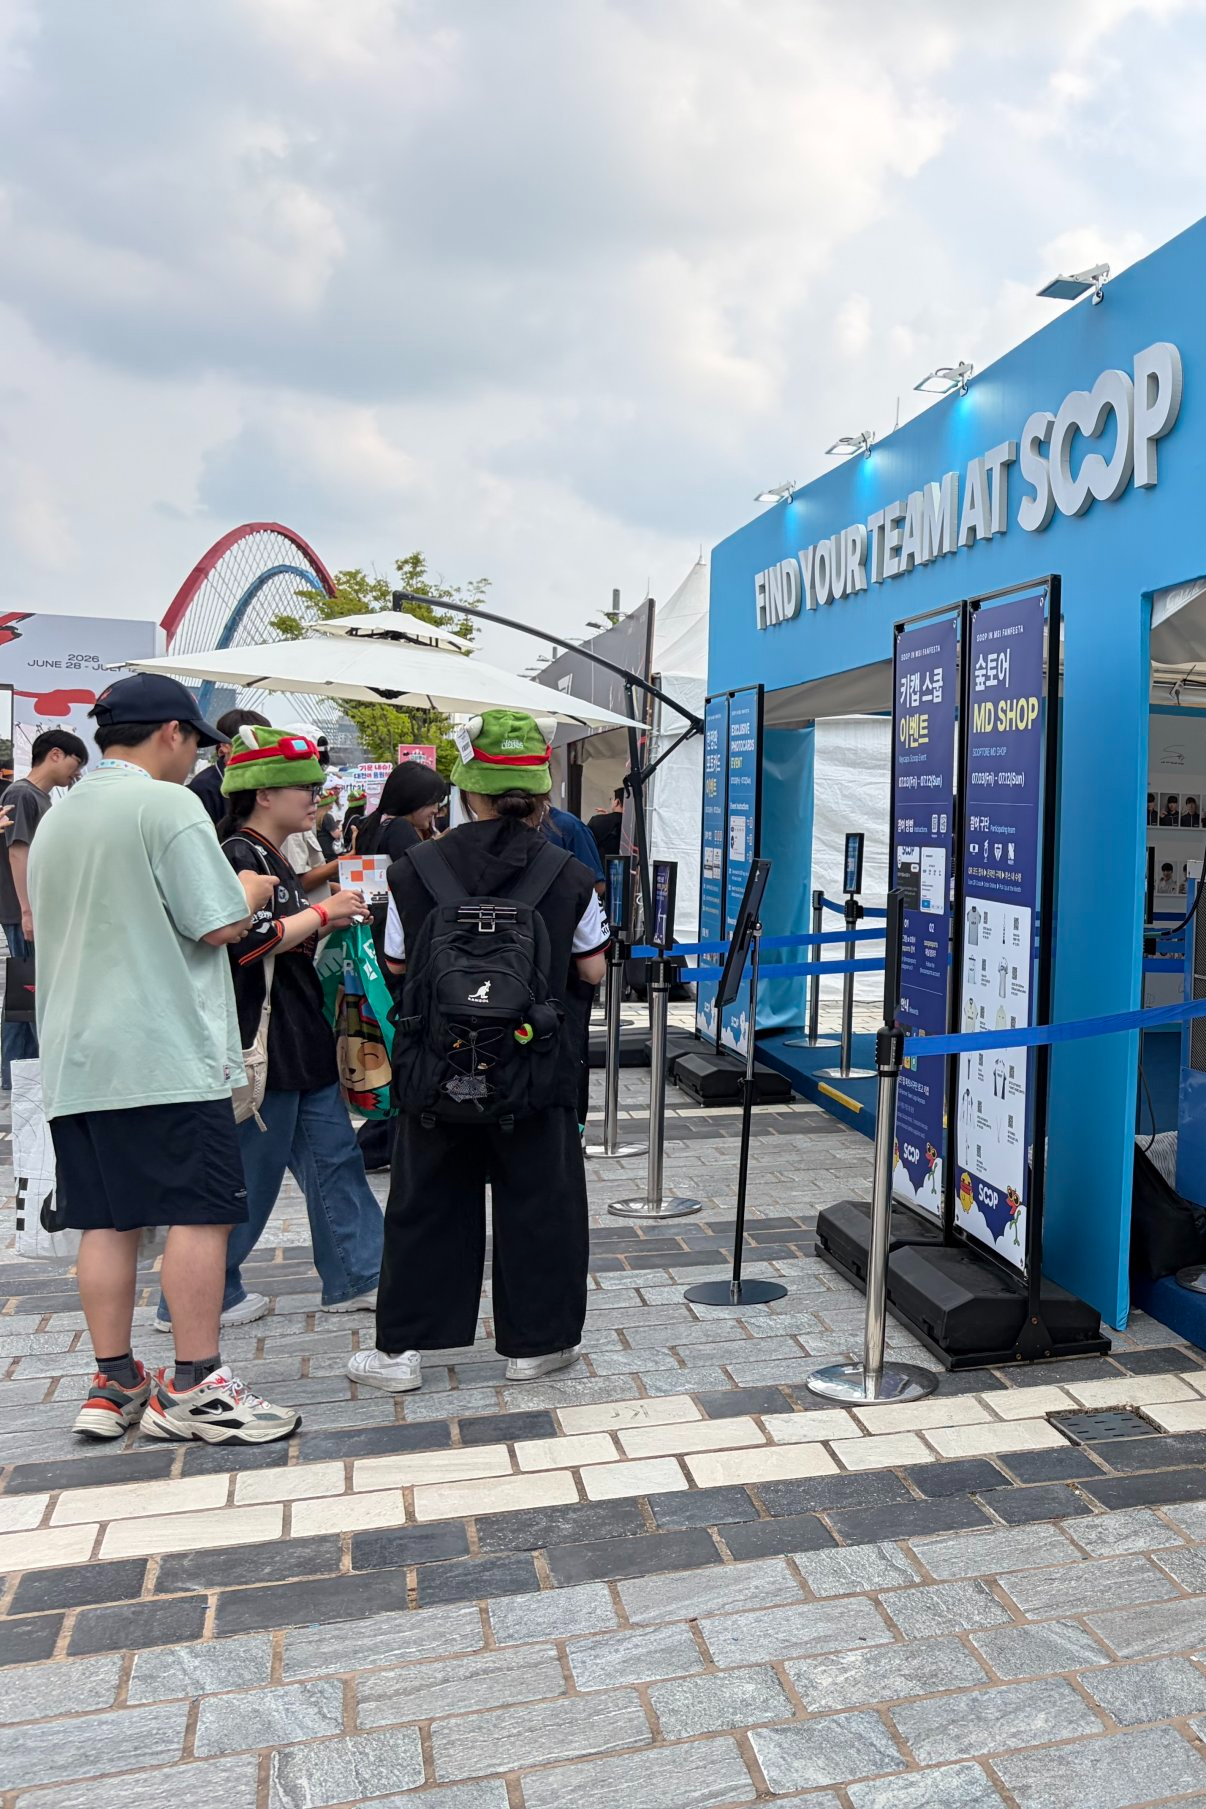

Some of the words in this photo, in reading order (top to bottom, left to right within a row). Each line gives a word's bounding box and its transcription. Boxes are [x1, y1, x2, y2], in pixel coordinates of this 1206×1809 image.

[754, 558, 801, 630] FIND
[798, 523, 868, 611] YOUR
[867, 471, 960, 584] TEAM
[958, 440, 1017, 548] AT
[1017, 341, 1183, 533] SOOP
[976, 632, 988, 642] SOOP
[988, 631, 993, 640] IN
[993, 629, 1002, 639] MSI
[1001, 624, 1024, 637] FANFESTA
[27, 659, 62, 668] JUNE
[65, 661, 82, 670] 28
[67, 653, 100, 663] 2026
[974, 648, 1011, 692] 숲토어
[900, 671, 920, 708] 키캡
[921, 667, 944, 704] 스쿱
[973, 701, 994, 734] MD
[997, 696, 1039, 733] SHOP
[900, 713, 929, 749] 이벤트
[903, 1142, 920, 1164] SOOP
[978, 1183, 999, 1210] SOOP
